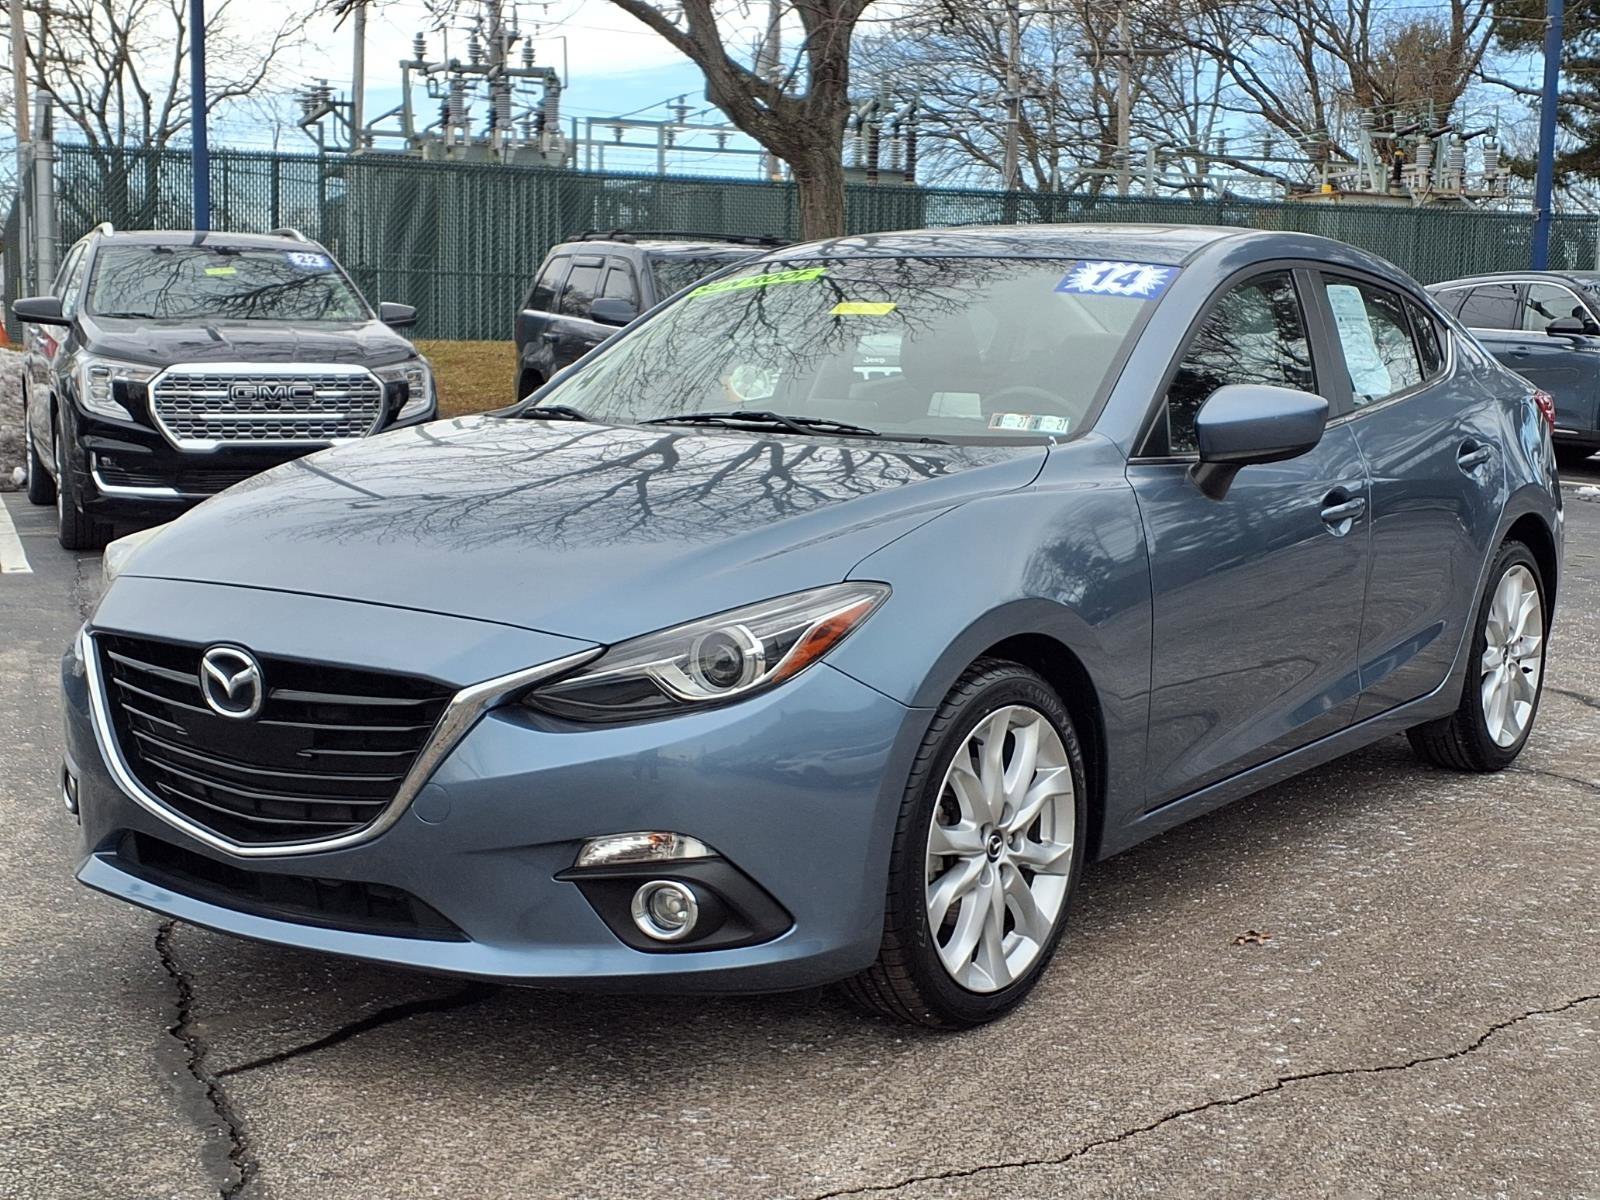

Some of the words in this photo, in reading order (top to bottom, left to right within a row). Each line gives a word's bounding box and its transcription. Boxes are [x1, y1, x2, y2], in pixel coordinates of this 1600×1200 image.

[297, 254, 319, 264] 22
[751, 270, 815, 284] ROOF
[1092, 267, 1141, 288] 14
[230, 385, 314, 401] GMC
